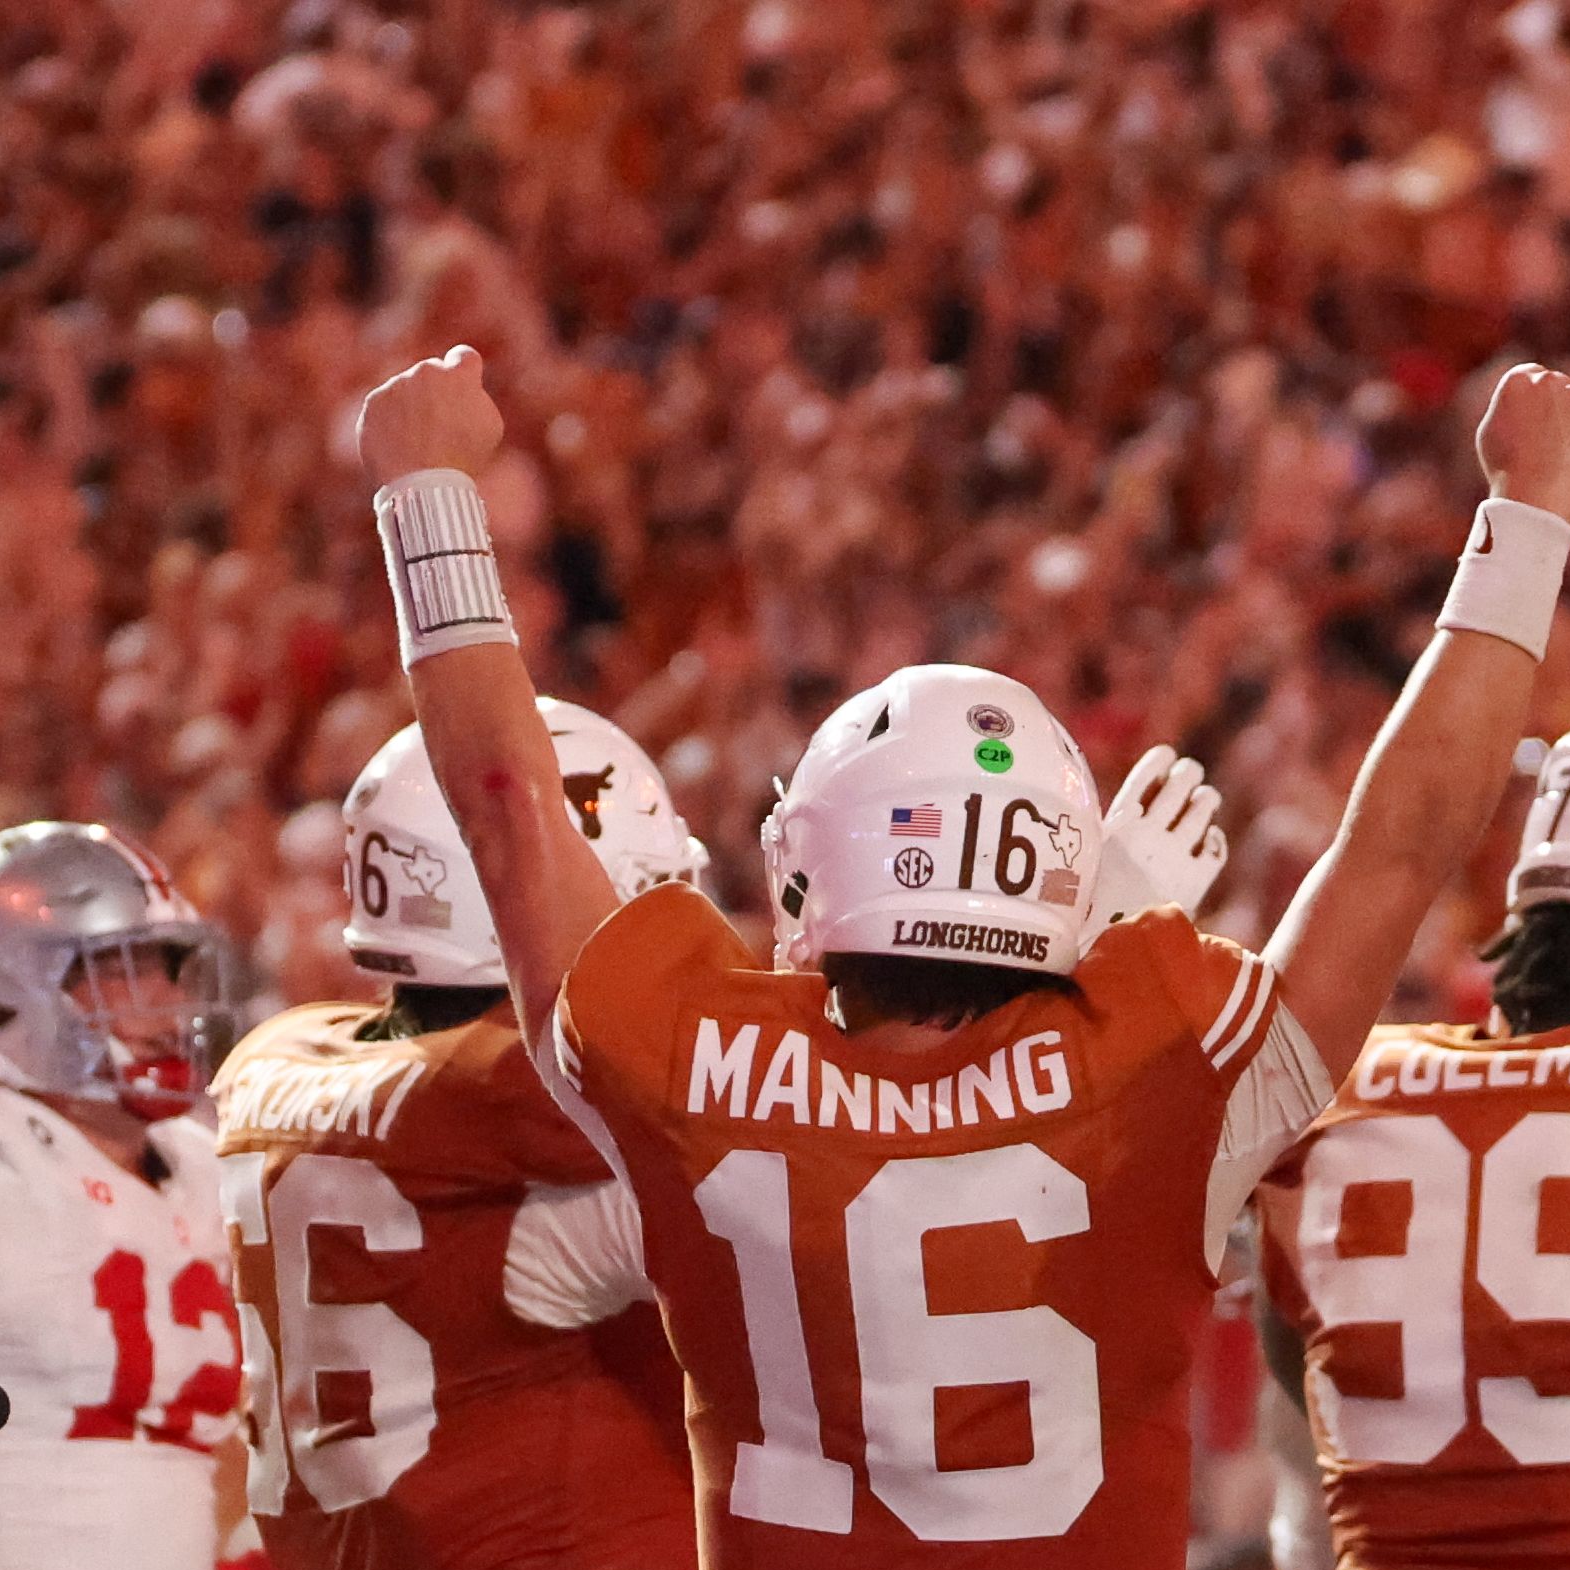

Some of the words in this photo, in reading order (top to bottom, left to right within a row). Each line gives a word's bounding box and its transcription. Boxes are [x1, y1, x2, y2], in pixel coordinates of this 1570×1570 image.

[977, 747, 1011, 764] C2P
[360, 831, 389, 919] 6
[895, 848, 934, 888] SEC
[958, 792, 1042, 897] 16
[892, 919, 1050, 963] LONGHORNS
[687, 1017, 1073, 1134] MANNING
[692, 1142, 1105, 1542] 16
